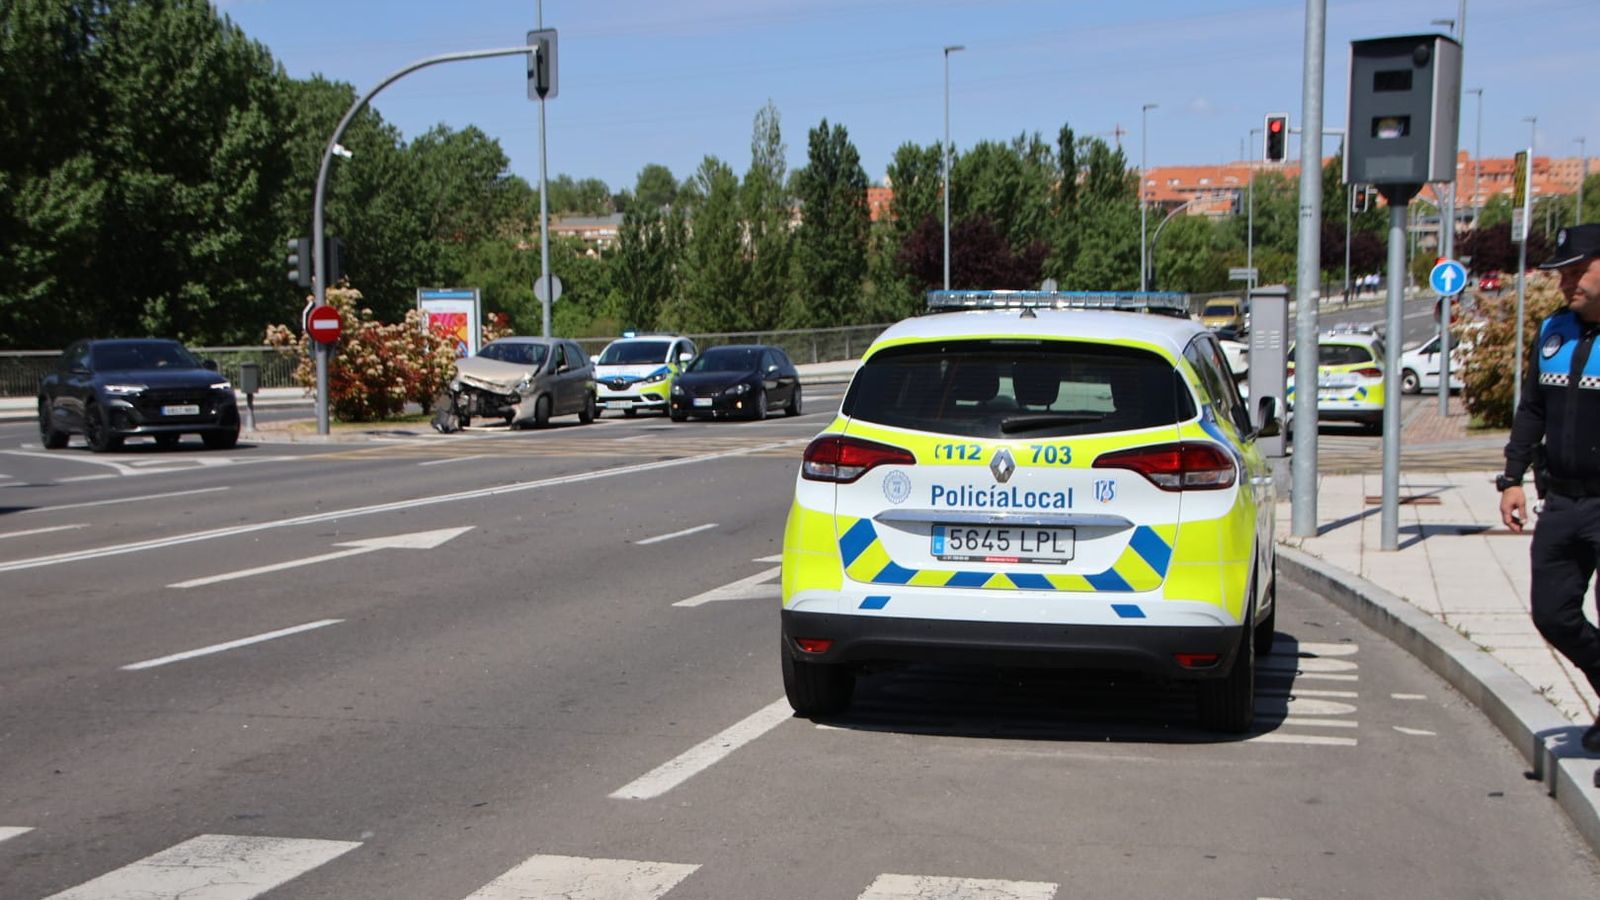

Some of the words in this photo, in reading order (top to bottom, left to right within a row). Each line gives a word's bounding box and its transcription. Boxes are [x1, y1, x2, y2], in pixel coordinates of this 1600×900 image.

[1031, 446, 1072, 464] 703
[950, 529, 1010, 550] 5645
[1020, 530, 1066, 553] LPL
